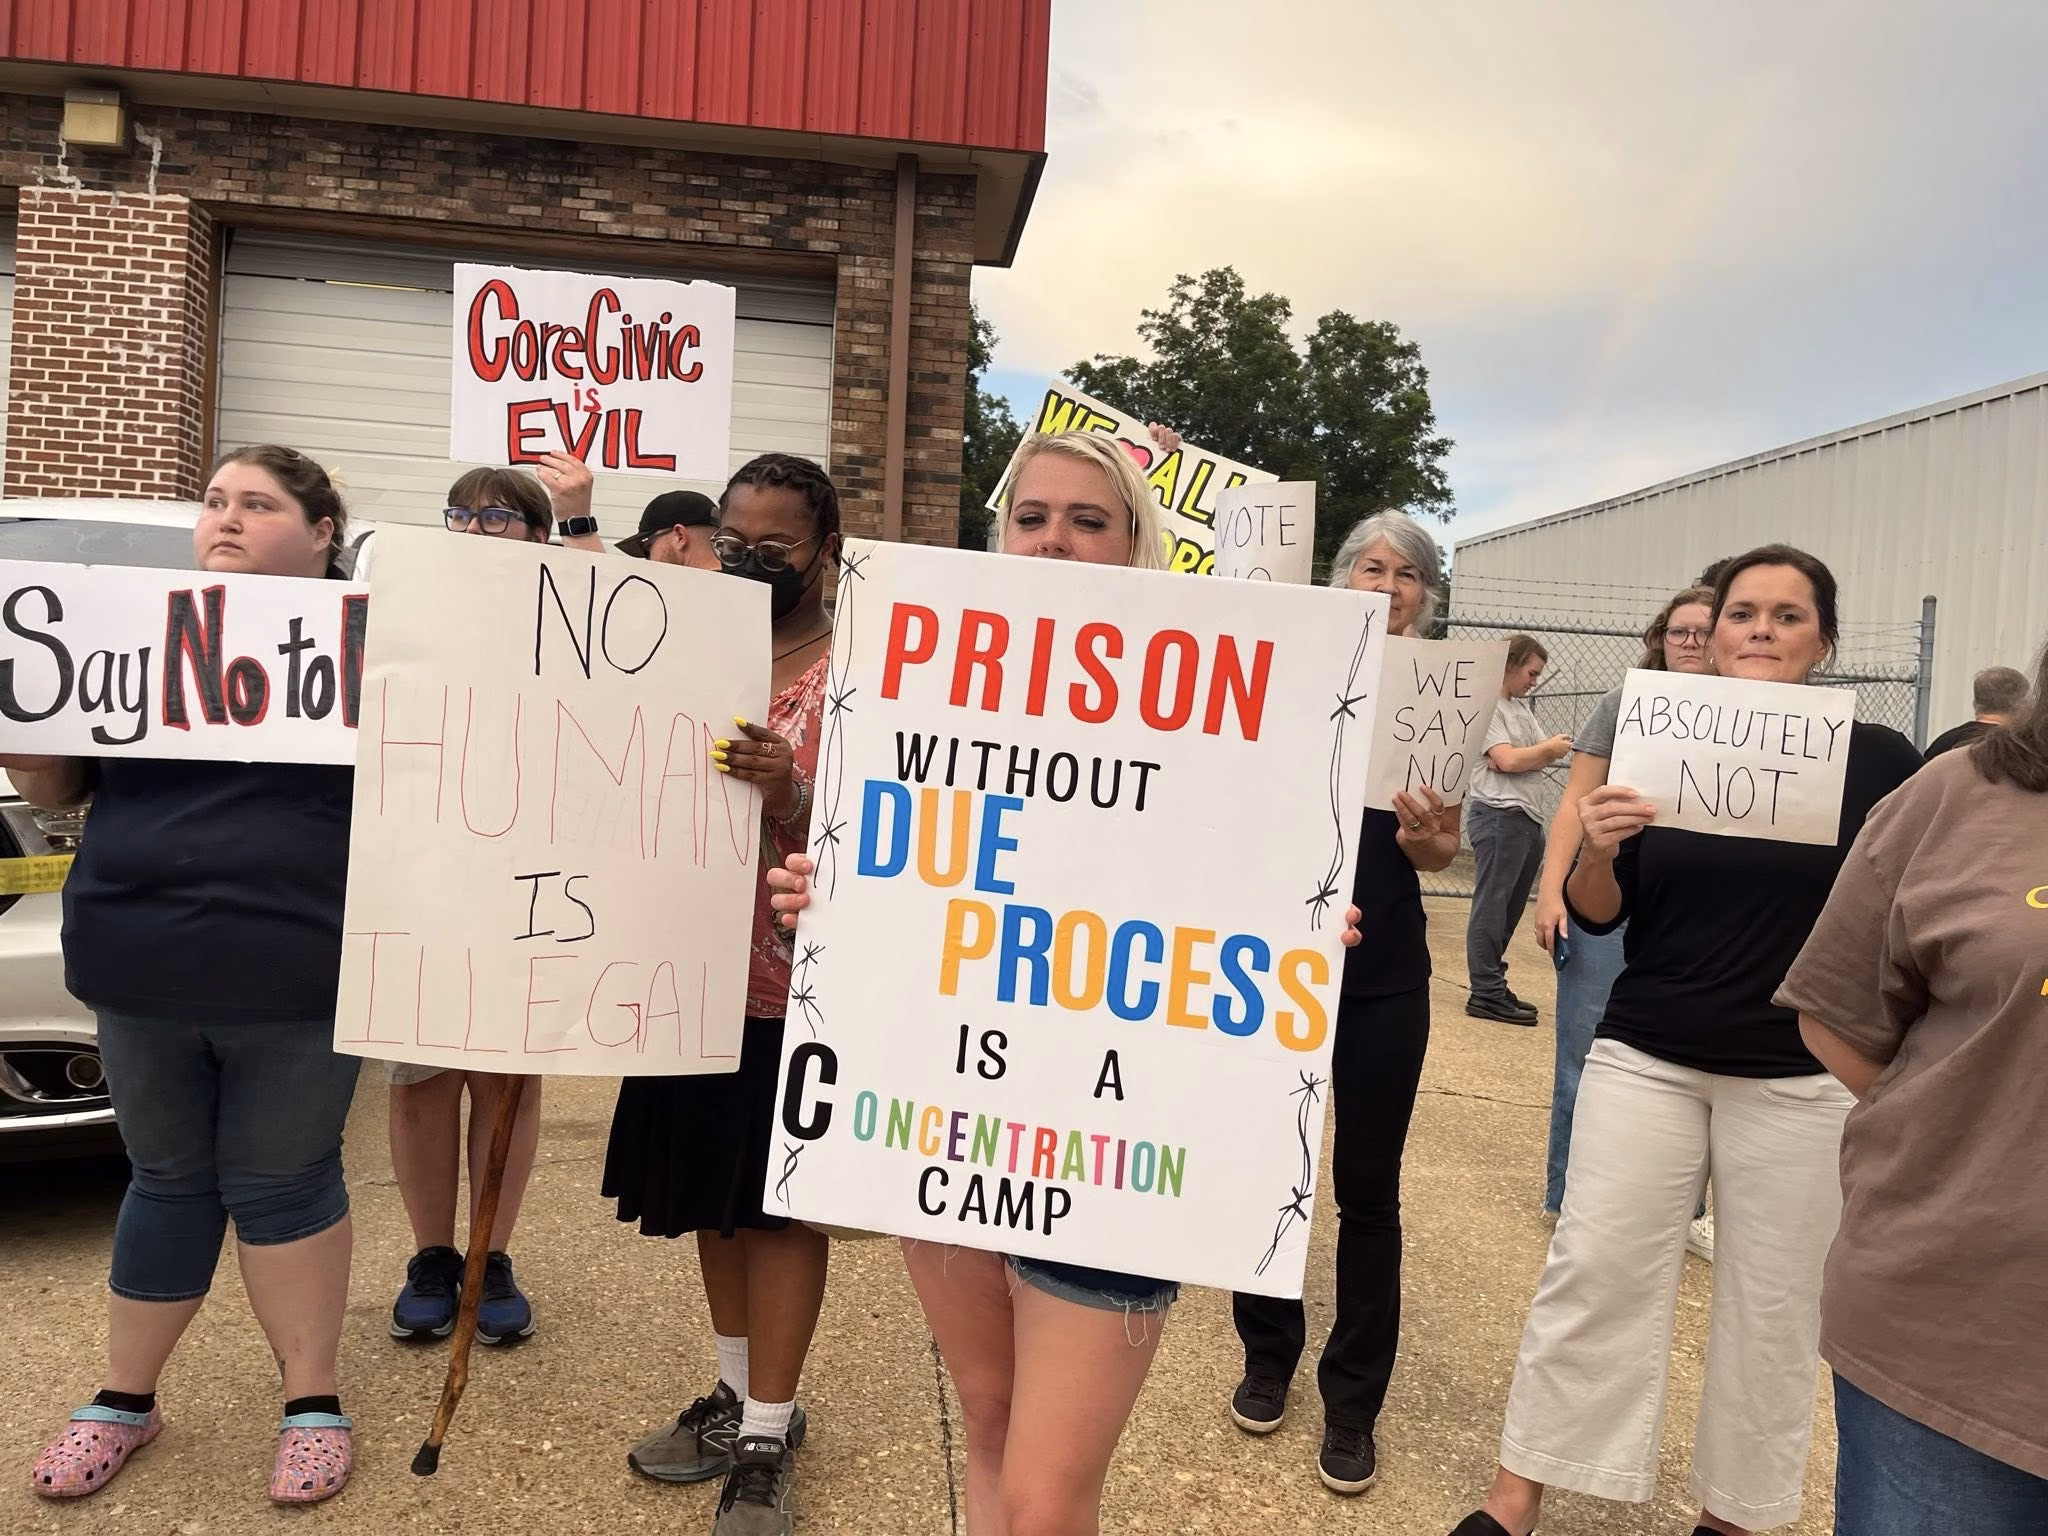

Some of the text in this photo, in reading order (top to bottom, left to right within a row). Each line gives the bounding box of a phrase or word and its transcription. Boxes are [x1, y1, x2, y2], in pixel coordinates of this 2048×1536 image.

[467, 279, 704, 386] CoreCivic
[507, 398, 677, 472] EVIL
[573, 382, 602, 413] is
[1218, 505, 1297, 549] VOTE
[535, 563, 668, 679] NO
[0, 585, 151, 745] Say
[163, 585, 270, 731] No
[278, 617, 336, 720] to
[880, 602, 1274, 741] PRISON
[1413, 657, 1475, 698] WE
[1393, 706, 1480, 746] SAY
[1620, 696, 1845, 762] ABSOLUTELY
[380, 677, 754, 869] HUMAN
[896, 731, 1161, 811] WITHOUT
[1405, 752, 1465, 793] NO
[1677, 759, 1798, 826] NOT
[857, 779, 1024, 895] DUE
[513, 871, 595, 943] IS
[341, 932, 736, 1059] ILLEGAL
[939, 899, 1330, 1052] PROCESS
[956, 1024, 1124, 1100] IS A
[918, 1166, 1072, 1236] CAMP
